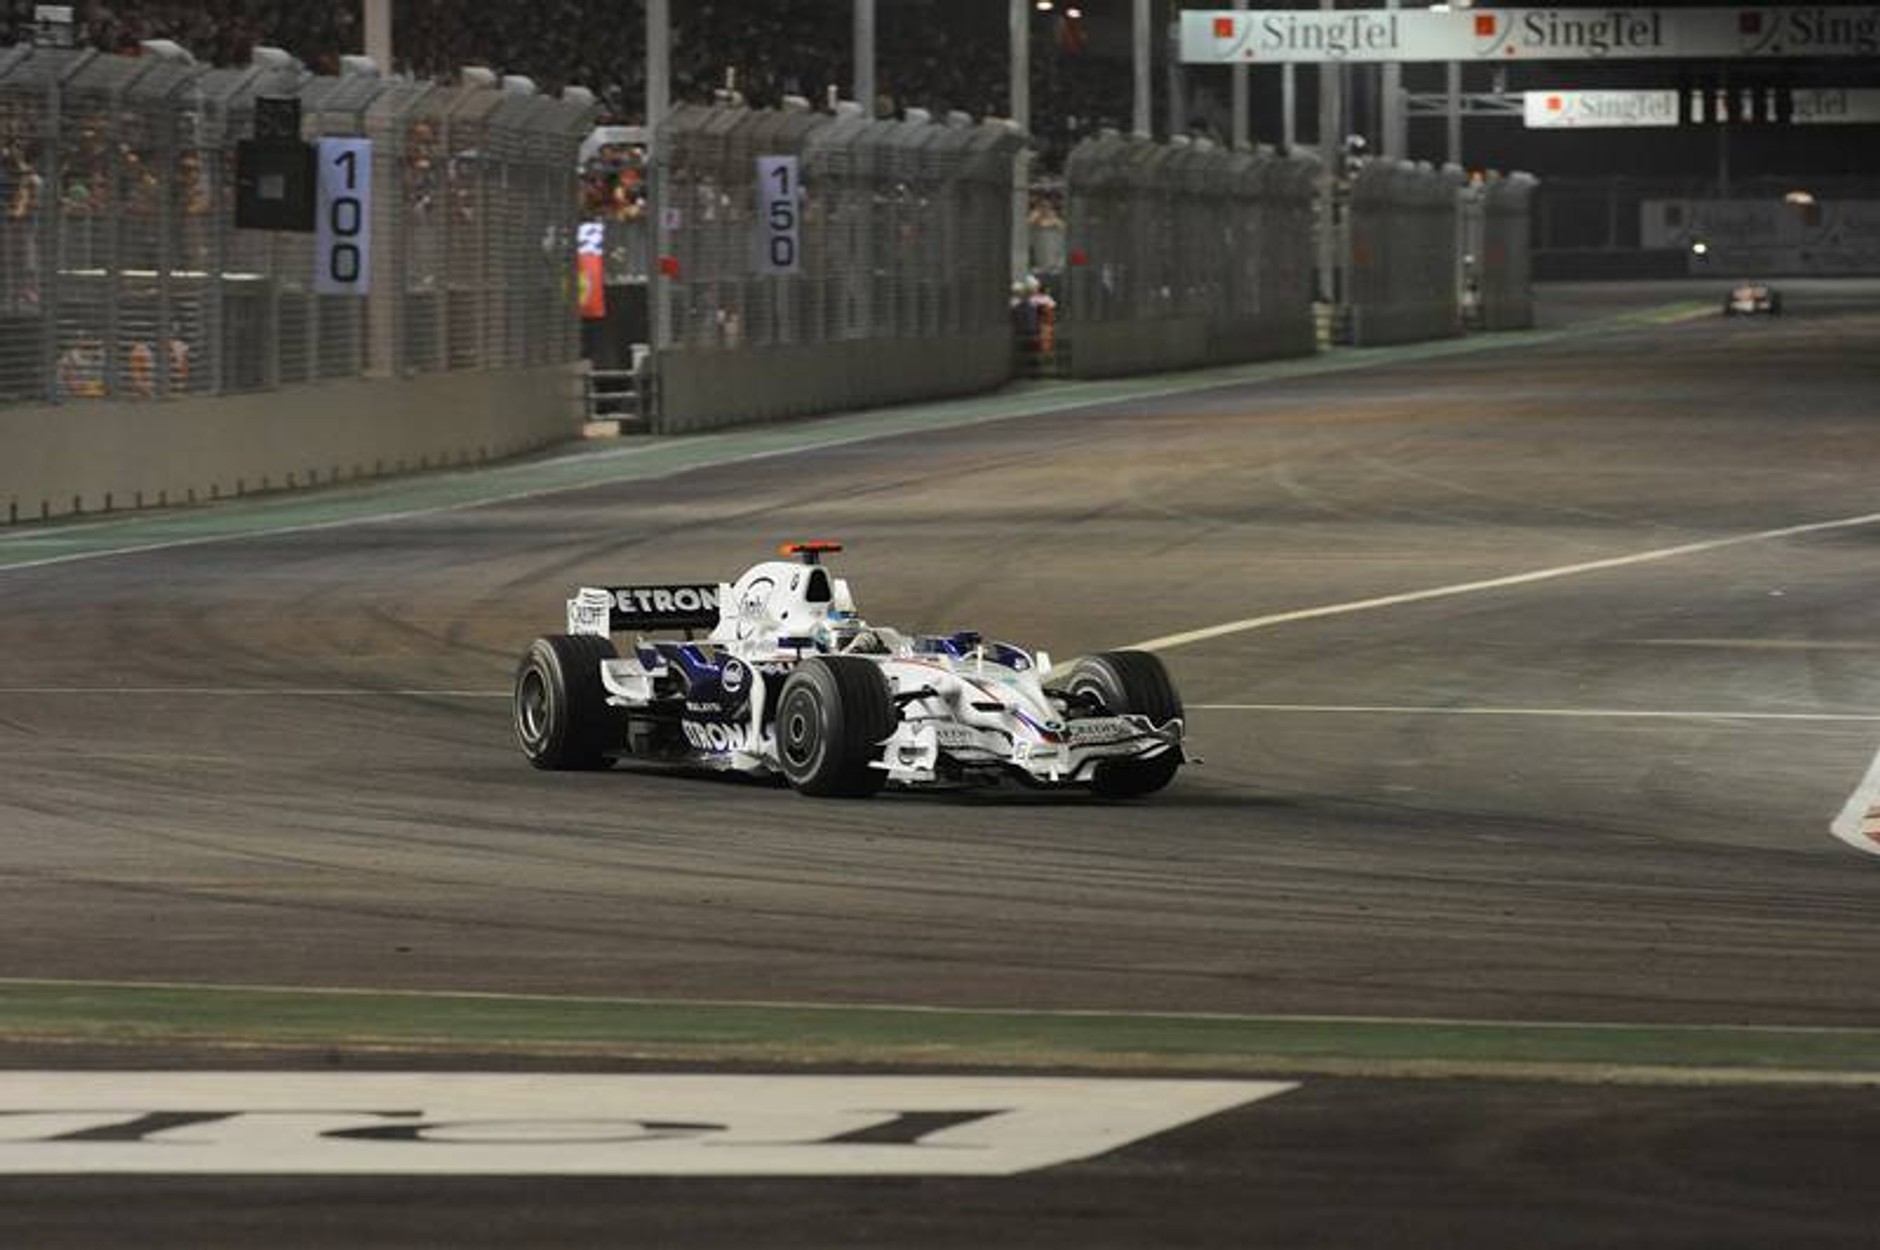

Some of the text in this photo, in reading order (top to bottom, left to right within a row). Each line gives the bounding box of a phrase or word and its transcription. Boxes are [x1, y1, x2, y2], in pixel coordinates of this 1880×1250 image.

[1261, 13, 1399, 57] SingTel
[1523, 9, 1663, 57] SingTel
[1580, 93, 1672, 122] SingTel
[331, 150, 361, 283] 100
[770, 165, 794, 267] 150
